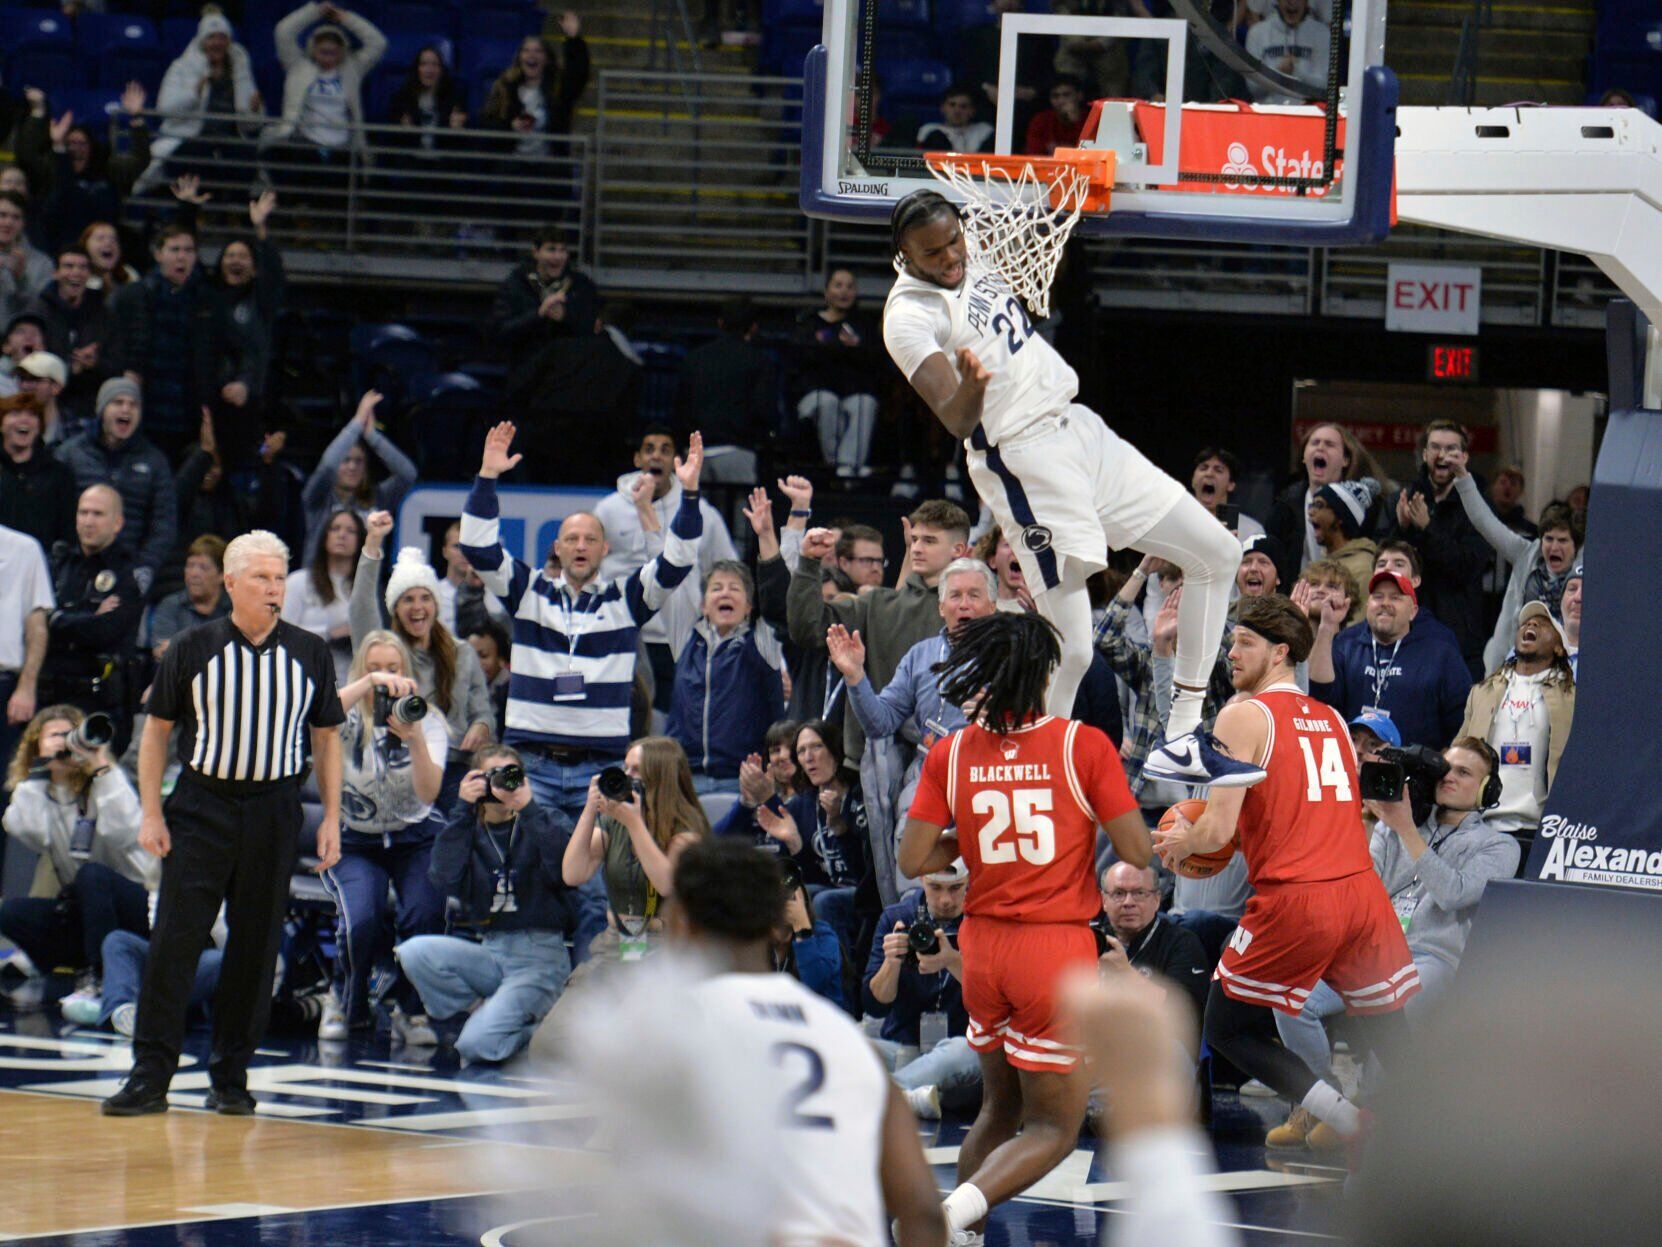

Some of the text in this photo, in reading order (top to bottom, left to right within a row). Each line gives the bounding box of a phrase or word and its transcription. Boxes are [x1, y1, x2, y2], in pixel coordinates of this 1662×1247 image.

[838, 181, 889, 196] SPALDING
[1394, 279, 1474, 313] EXIT
[992, 297, 1034, 355] 22
[1434, 346, 1472, 378] EXIT
[1292, 717, 1333, 733] GILMORE
[969, 764, 1051, 783] BLACKWELL
[1298, 736, 1353, 802] 14
[971, 788, 1056, 866] 25
[1541, 814, 1598, 841] Blaise
[1582, 871, 1615, 884] FAMILY
[770, 1040, 837, 1132] 2
